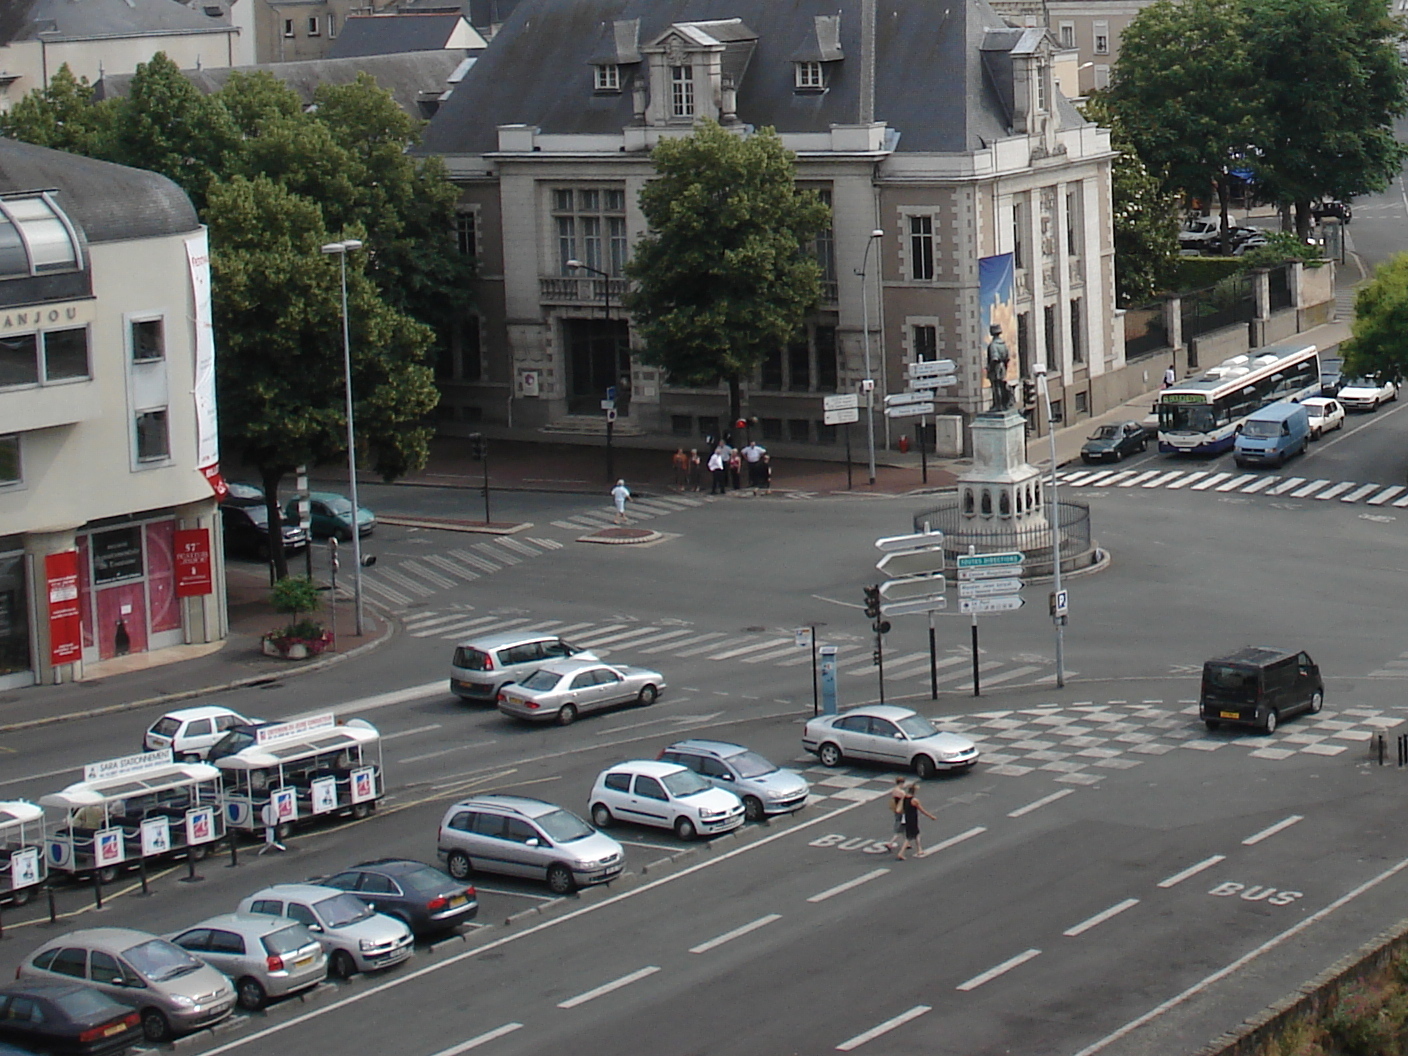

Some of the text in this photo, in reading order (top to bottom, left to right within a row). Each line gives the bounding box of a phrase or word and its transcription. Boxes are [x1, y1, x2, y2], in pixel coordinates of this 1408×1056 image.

[4, 307, 76, 327] ANJOU
[100, 762, 118, 772] SARA
[808, 833, 898, 853] BUS
[1208, 882, 1303, 905] BUS
